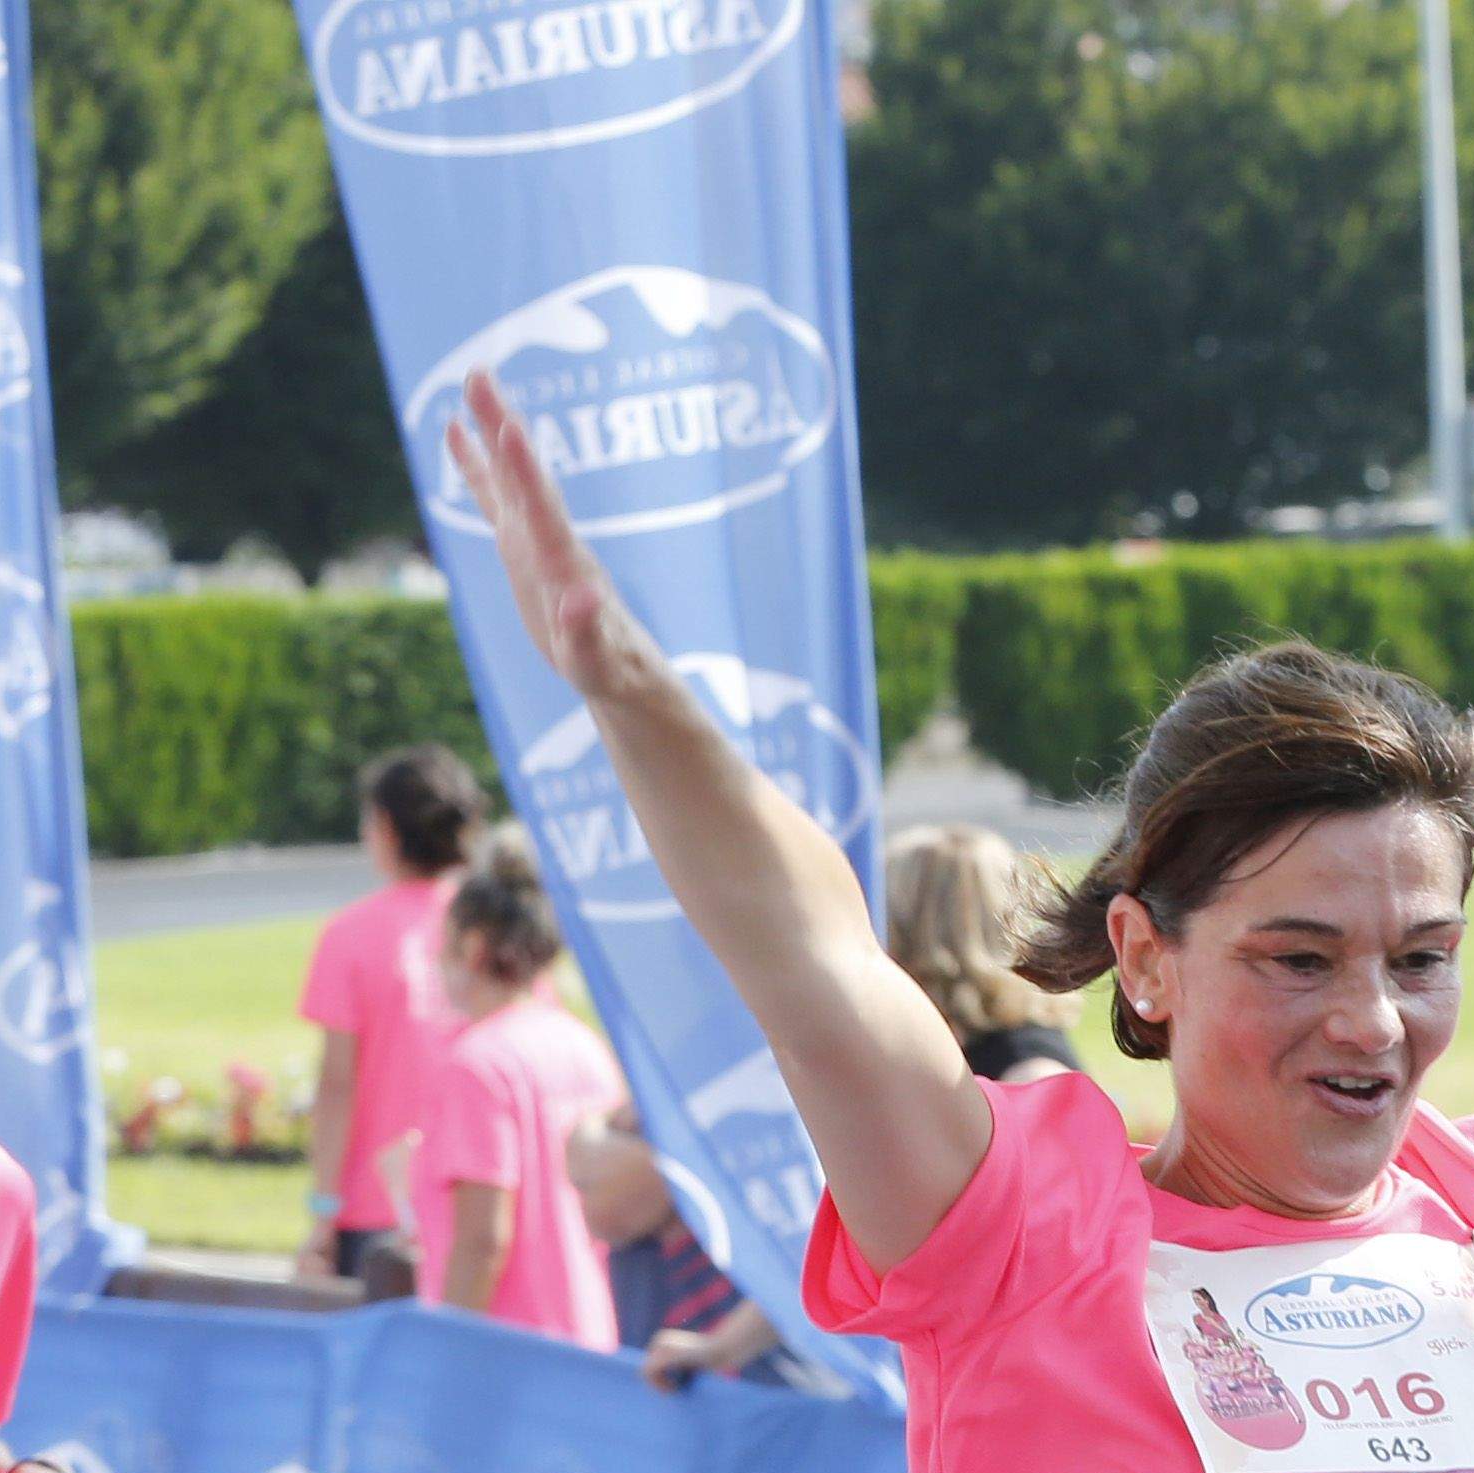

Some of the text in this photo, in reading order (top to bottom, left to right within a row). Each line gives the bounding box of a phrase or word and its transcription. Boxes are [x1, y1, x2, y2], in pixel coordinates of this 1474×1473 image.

[1263, 1302, 1415, 1333] ASTURIANA
[1305, 1372, 1445, 1421] 016
[1368, 1436, 1432, 1463] 643
